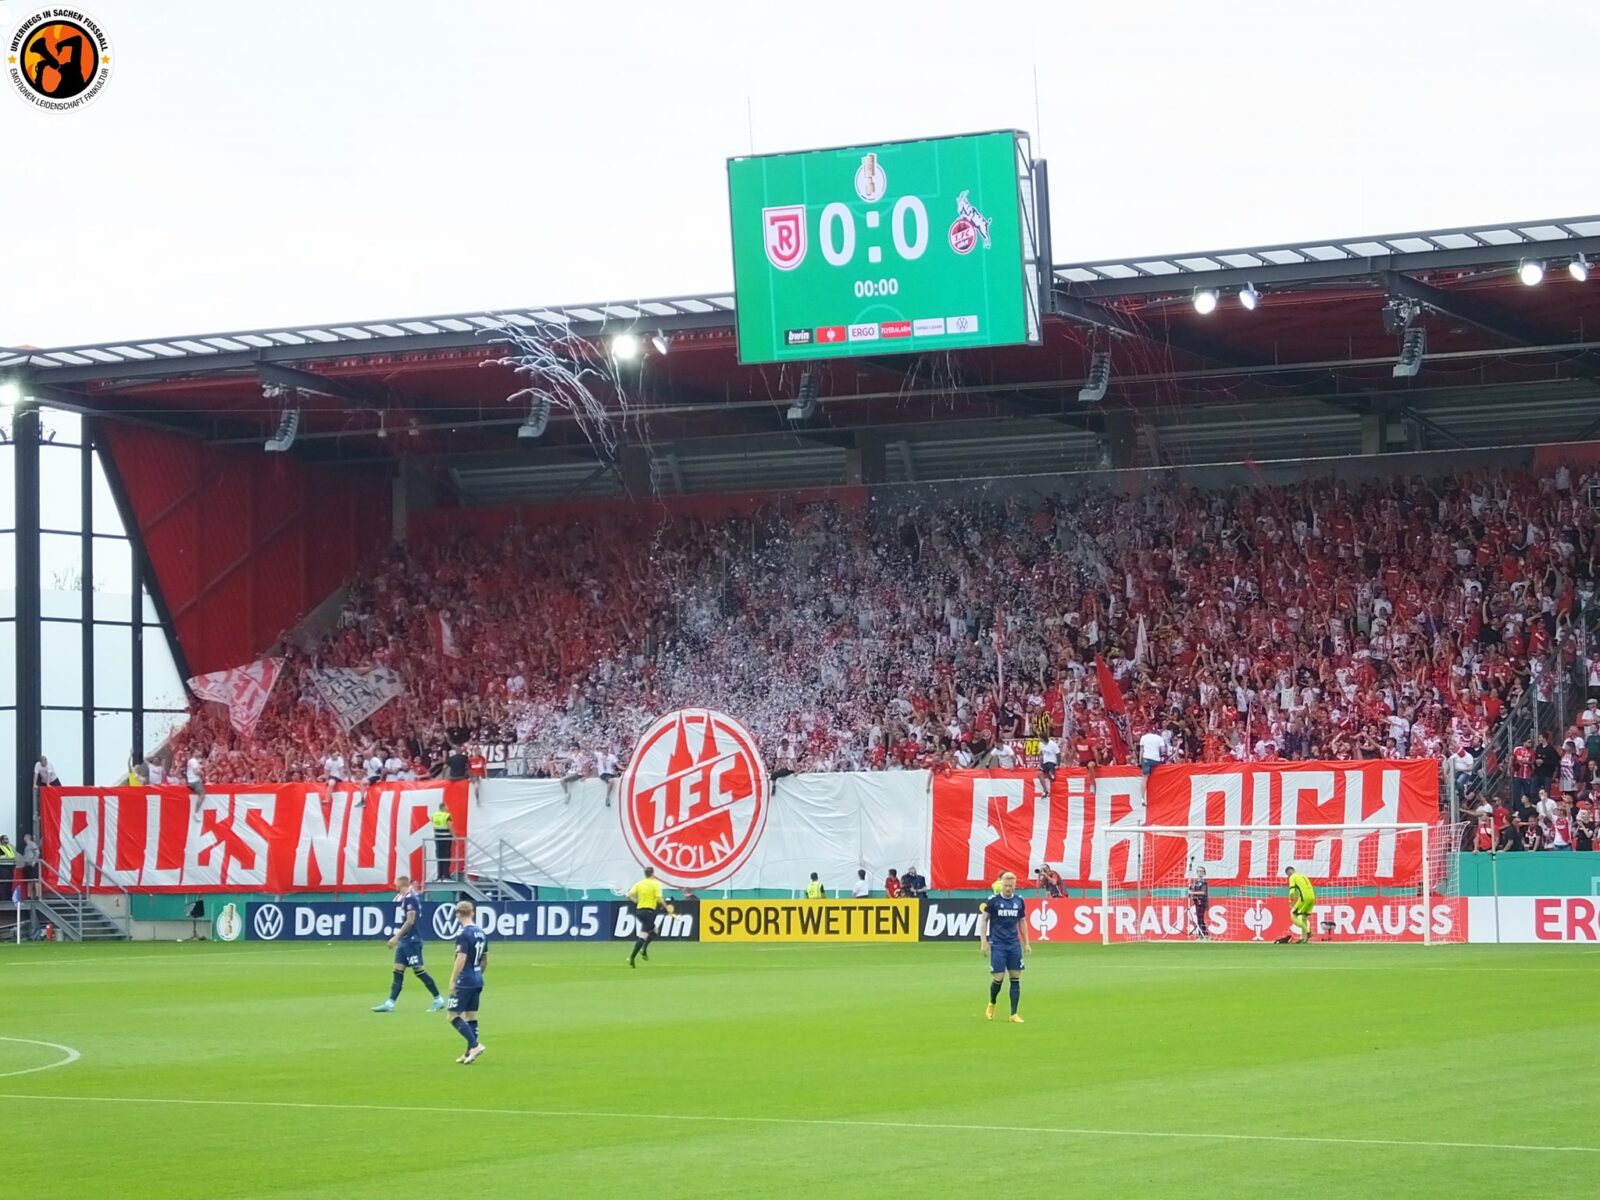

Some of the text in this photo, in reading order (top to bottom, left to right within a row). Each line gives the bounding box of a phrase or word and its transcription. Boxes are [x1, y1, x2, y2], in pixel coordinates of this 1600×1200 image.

[854, 278, 898, 297] 00:00
[788, 330, 809, 341] bwin
[852, 326, 875, 338] ERGO
[57, 788, 445, 886] ALLES NUR
[966, 769, 1401, 882] FÜR DICH
[655, 832, 732, 869] KÖLN
[295, 907, 346, 936] Der
[476, 906, 599, 936] Der ID.5
[709, 906, 910, 936] SPORTWETTEN
[997, 909, 1019, 917] REWE
[1535, 898, 1600, 940] ER
